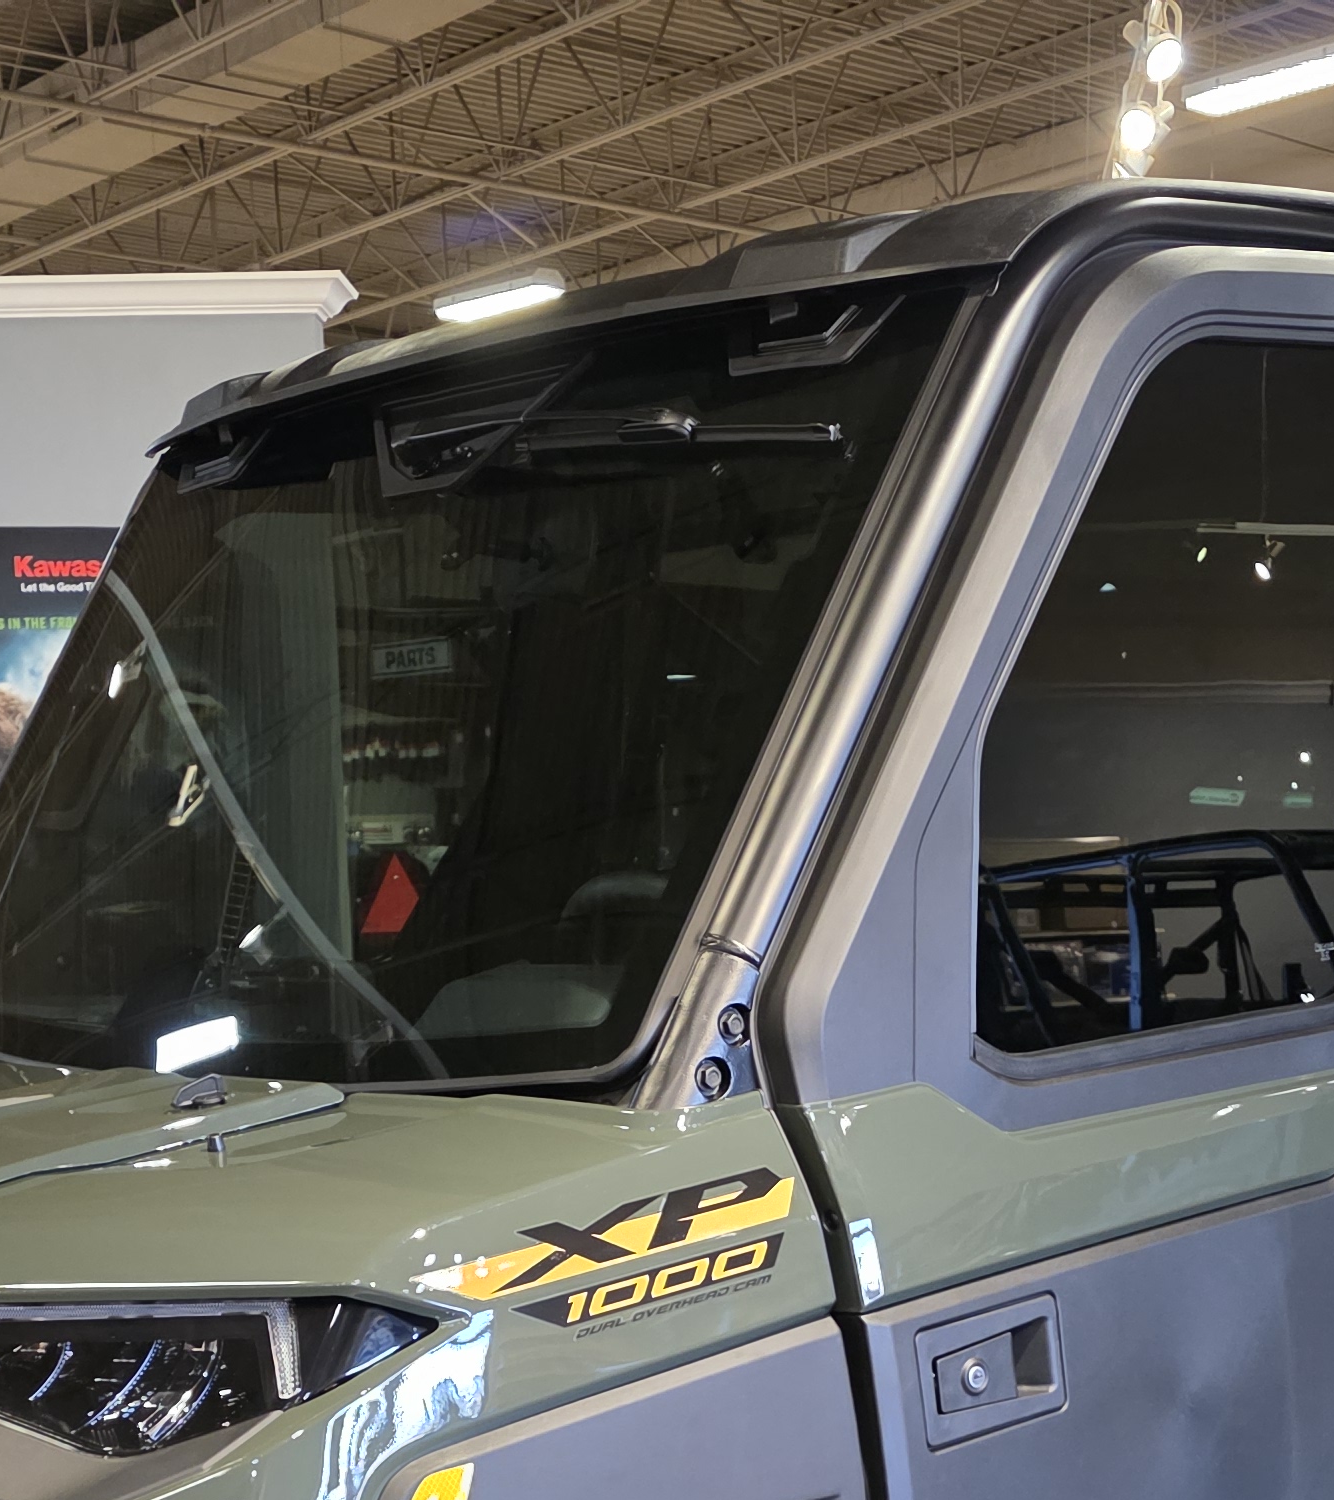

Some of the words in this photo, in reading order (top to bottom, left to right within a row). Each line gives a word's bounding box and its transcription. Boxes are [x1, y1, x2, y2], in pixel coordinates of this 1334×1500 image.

[14, 556, 104, 578] Kawas
[20, 583, 37, 592] Let
[39, 582, 55, 592] the
[57, 582, 84, 592] Good
[8, 617, 21, 630] IN
[24, 617, 46, 629] THE
[385, 646, 436, 669] PARTS
[491, 1166, 782, 1295] XP
[566, 1241, 768, 1324] 1000
[576, 1317, 627, 1340] DUAL
[632, 1286, 729, 1322] OVERHEAD
[733, 1274, 772, 1293] CAM
